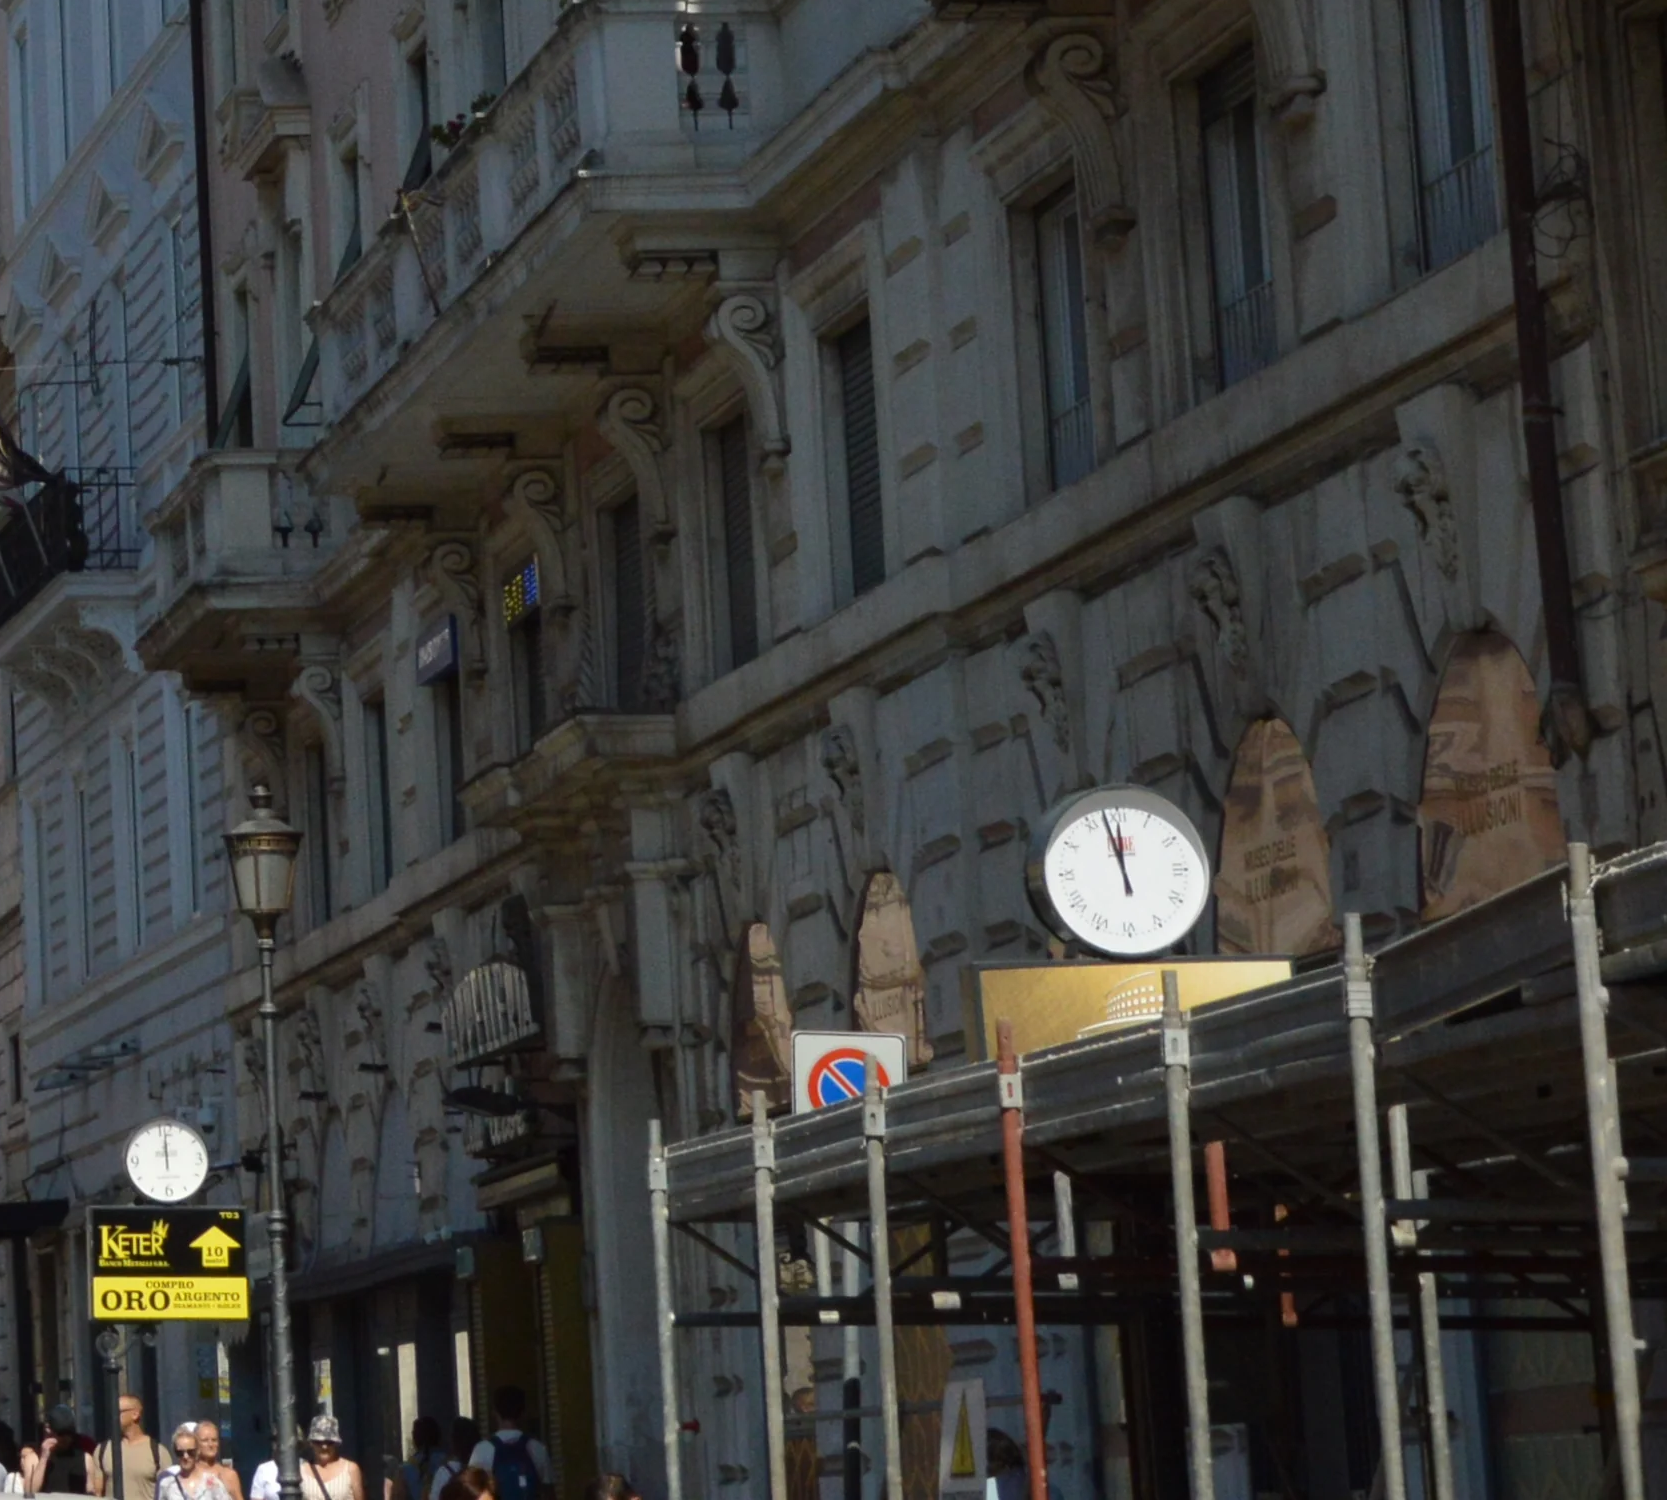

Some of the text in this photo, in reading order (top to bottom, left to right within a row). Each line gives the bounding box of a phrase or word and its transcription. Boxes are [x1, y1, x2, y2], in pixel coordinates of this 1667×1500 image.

[1459, 791, 1521, 838] ILLUSIONI
[1243, 836, 1297, 872] MUSEO DELLE
[130, 1155, 139, 1168] 9
[195, 1152, 204, 1166] 3
[165, 1184, 174, 1197] 6
[98, 1225, 164, 1259] KETER
[206, 1246, 223, 1257] 10
[145, 1280, 194, 1289] COMPRO
[101, 1289, 171, 1311] ORO
[173, 1292, 240, 1302] ARGENTO
